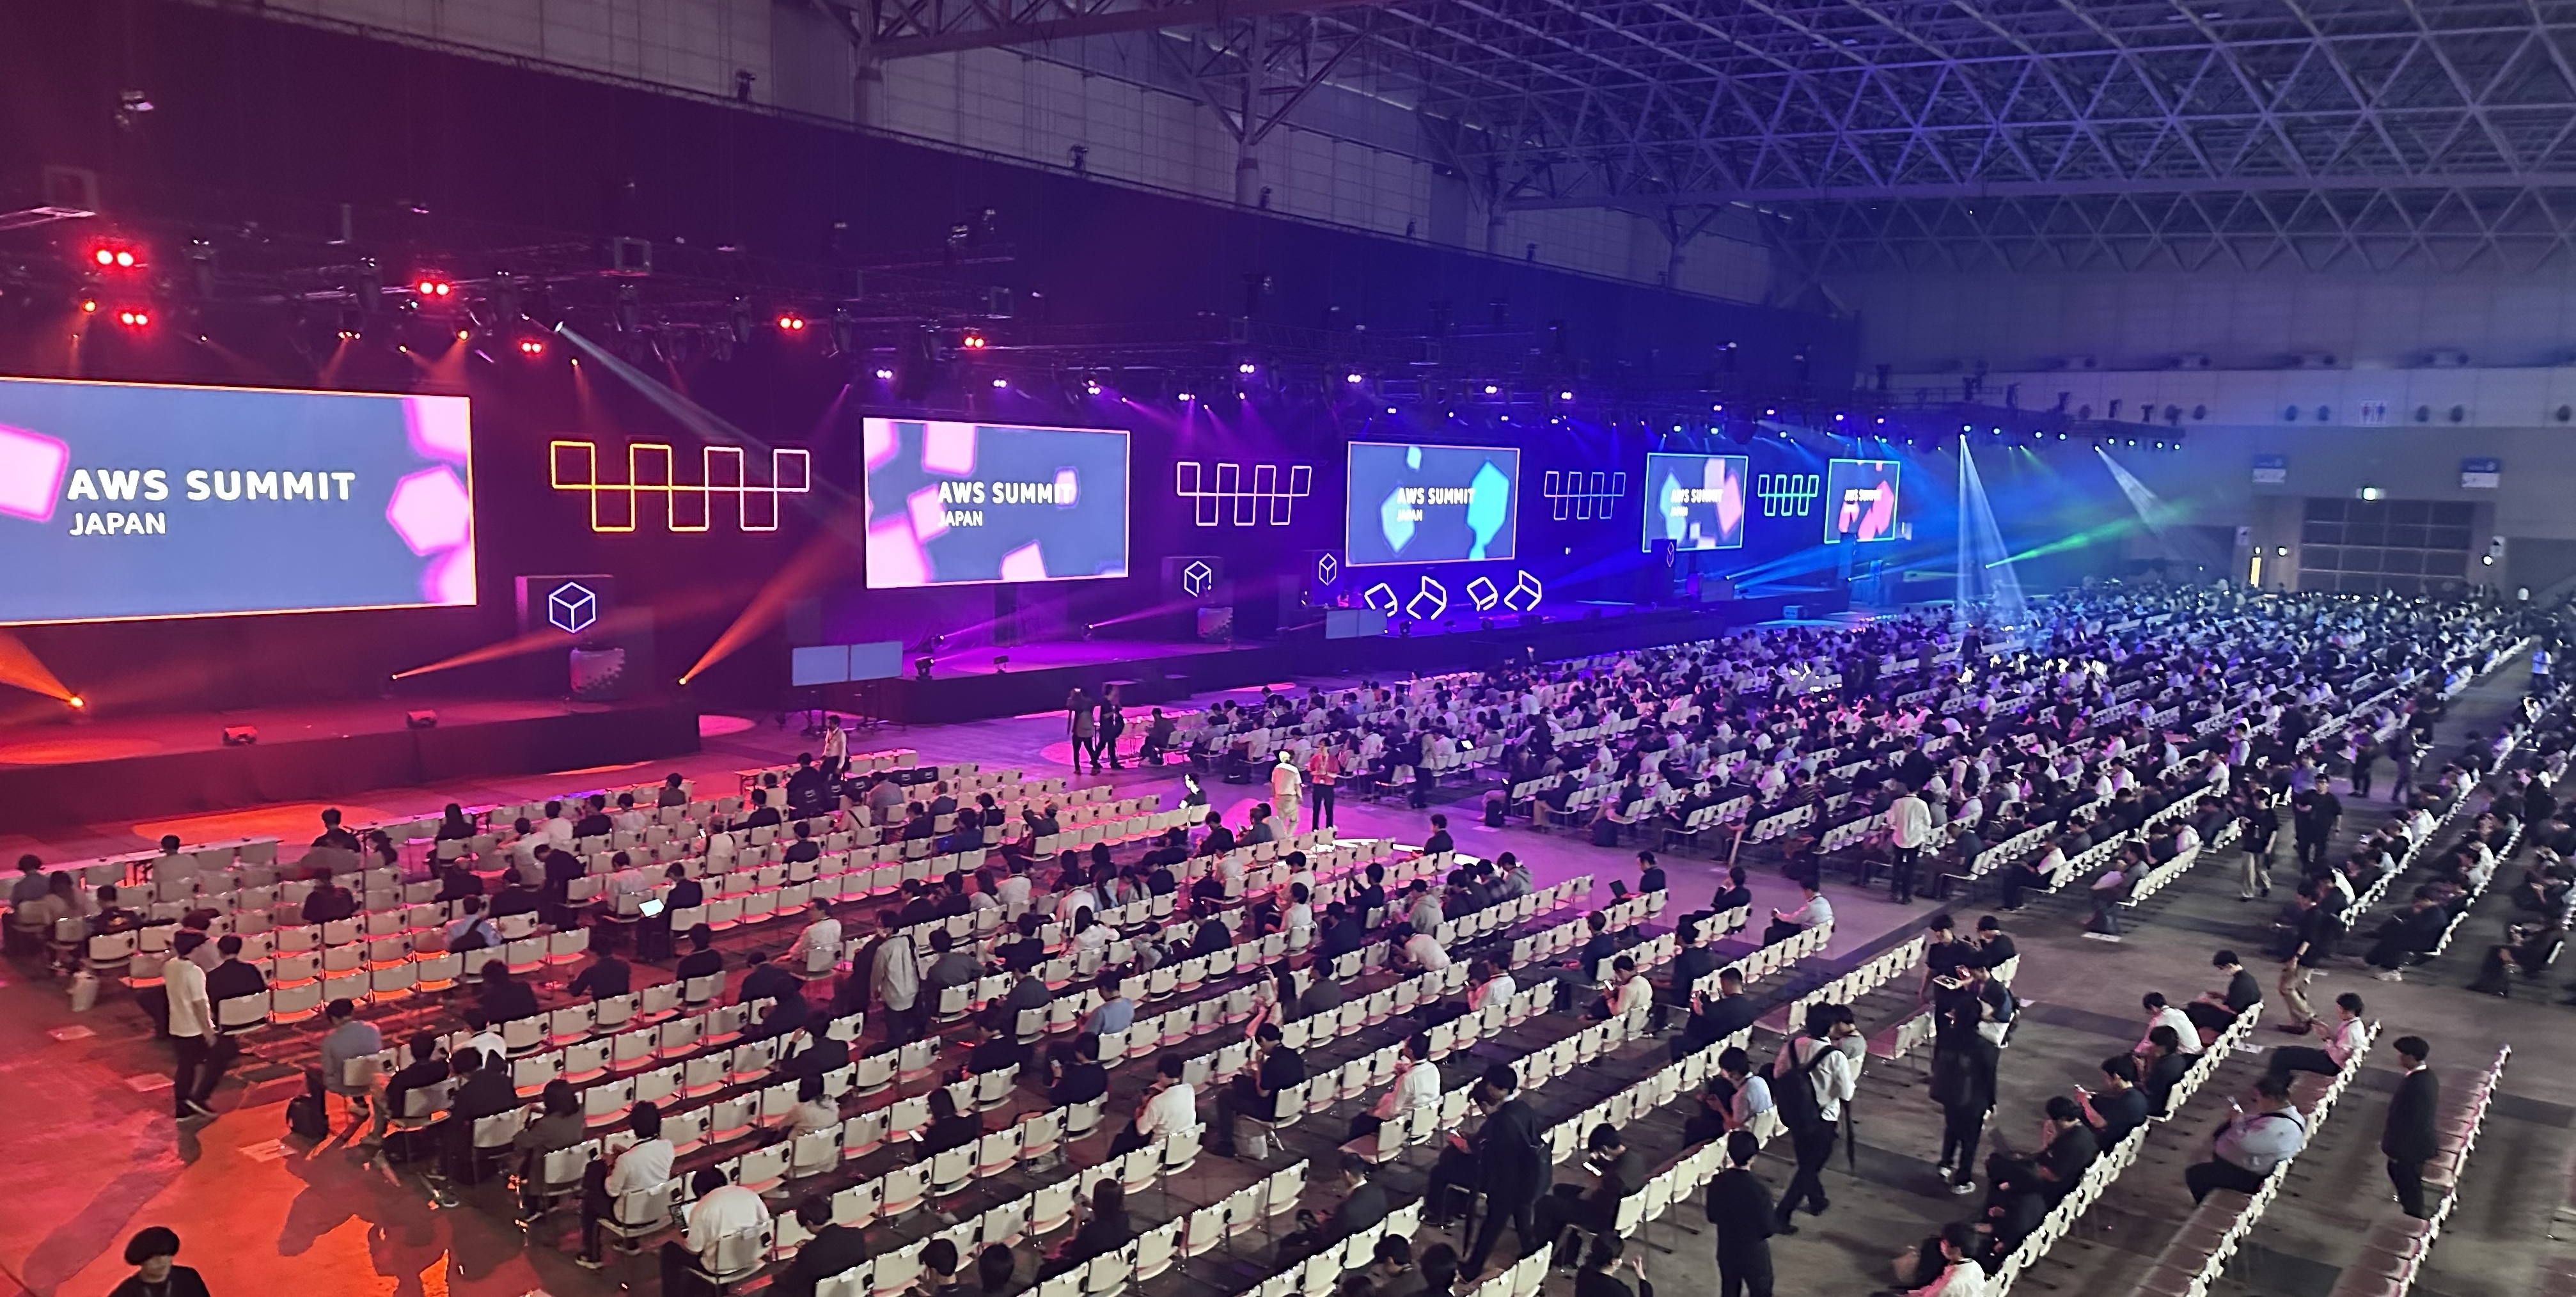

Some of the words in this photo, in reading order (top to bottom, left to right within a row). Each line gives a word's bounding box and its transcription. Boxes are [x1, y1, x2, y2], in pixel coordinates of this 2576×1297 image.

[67, 469, 169, 501] AWS
[185, 469, 356, 501] SUMMIT
[937, 481, 985, 504] AWS
[992, 482, 1072, 504] SUMMIT
[1397, 487, 1425, 505] AWS
[1427, 487, 1476, 505] SUMMIT
[69, 512, 166, 536] JAPAN
[938, 510, 983, 527] JAPAN
